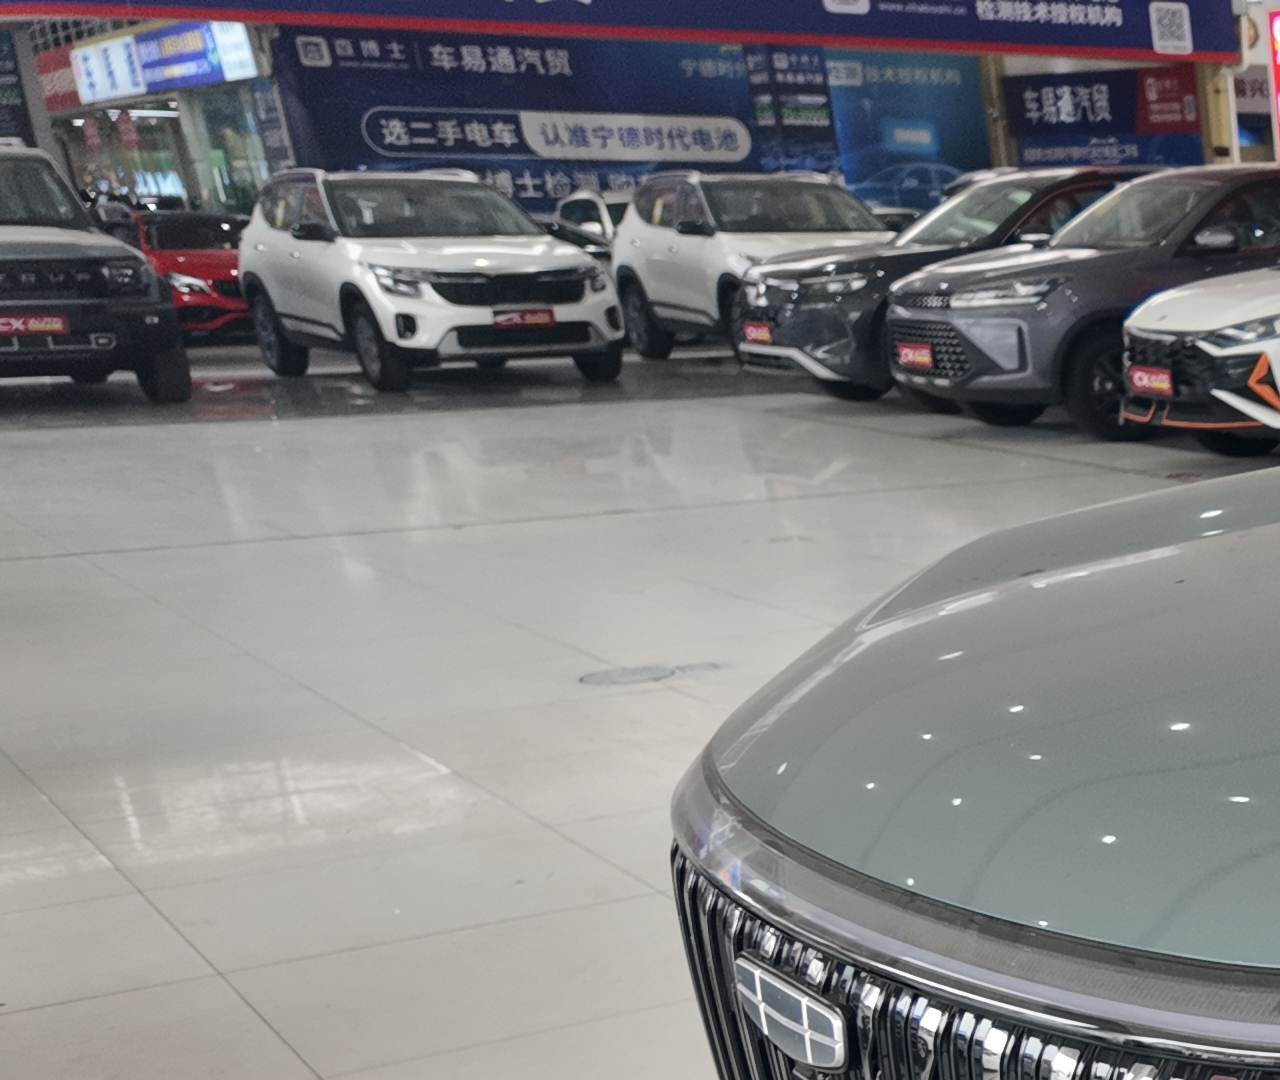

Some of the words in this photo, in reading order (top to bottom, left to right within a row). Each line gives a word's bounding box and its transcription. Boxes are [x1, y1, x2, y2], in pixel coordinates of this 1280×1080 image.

[429, 43, 573, 76] 车易通汽贸
[380, 118, 519, 148] 选二手电车
[539, 121, 741, 152] 认准宁德时代电池
